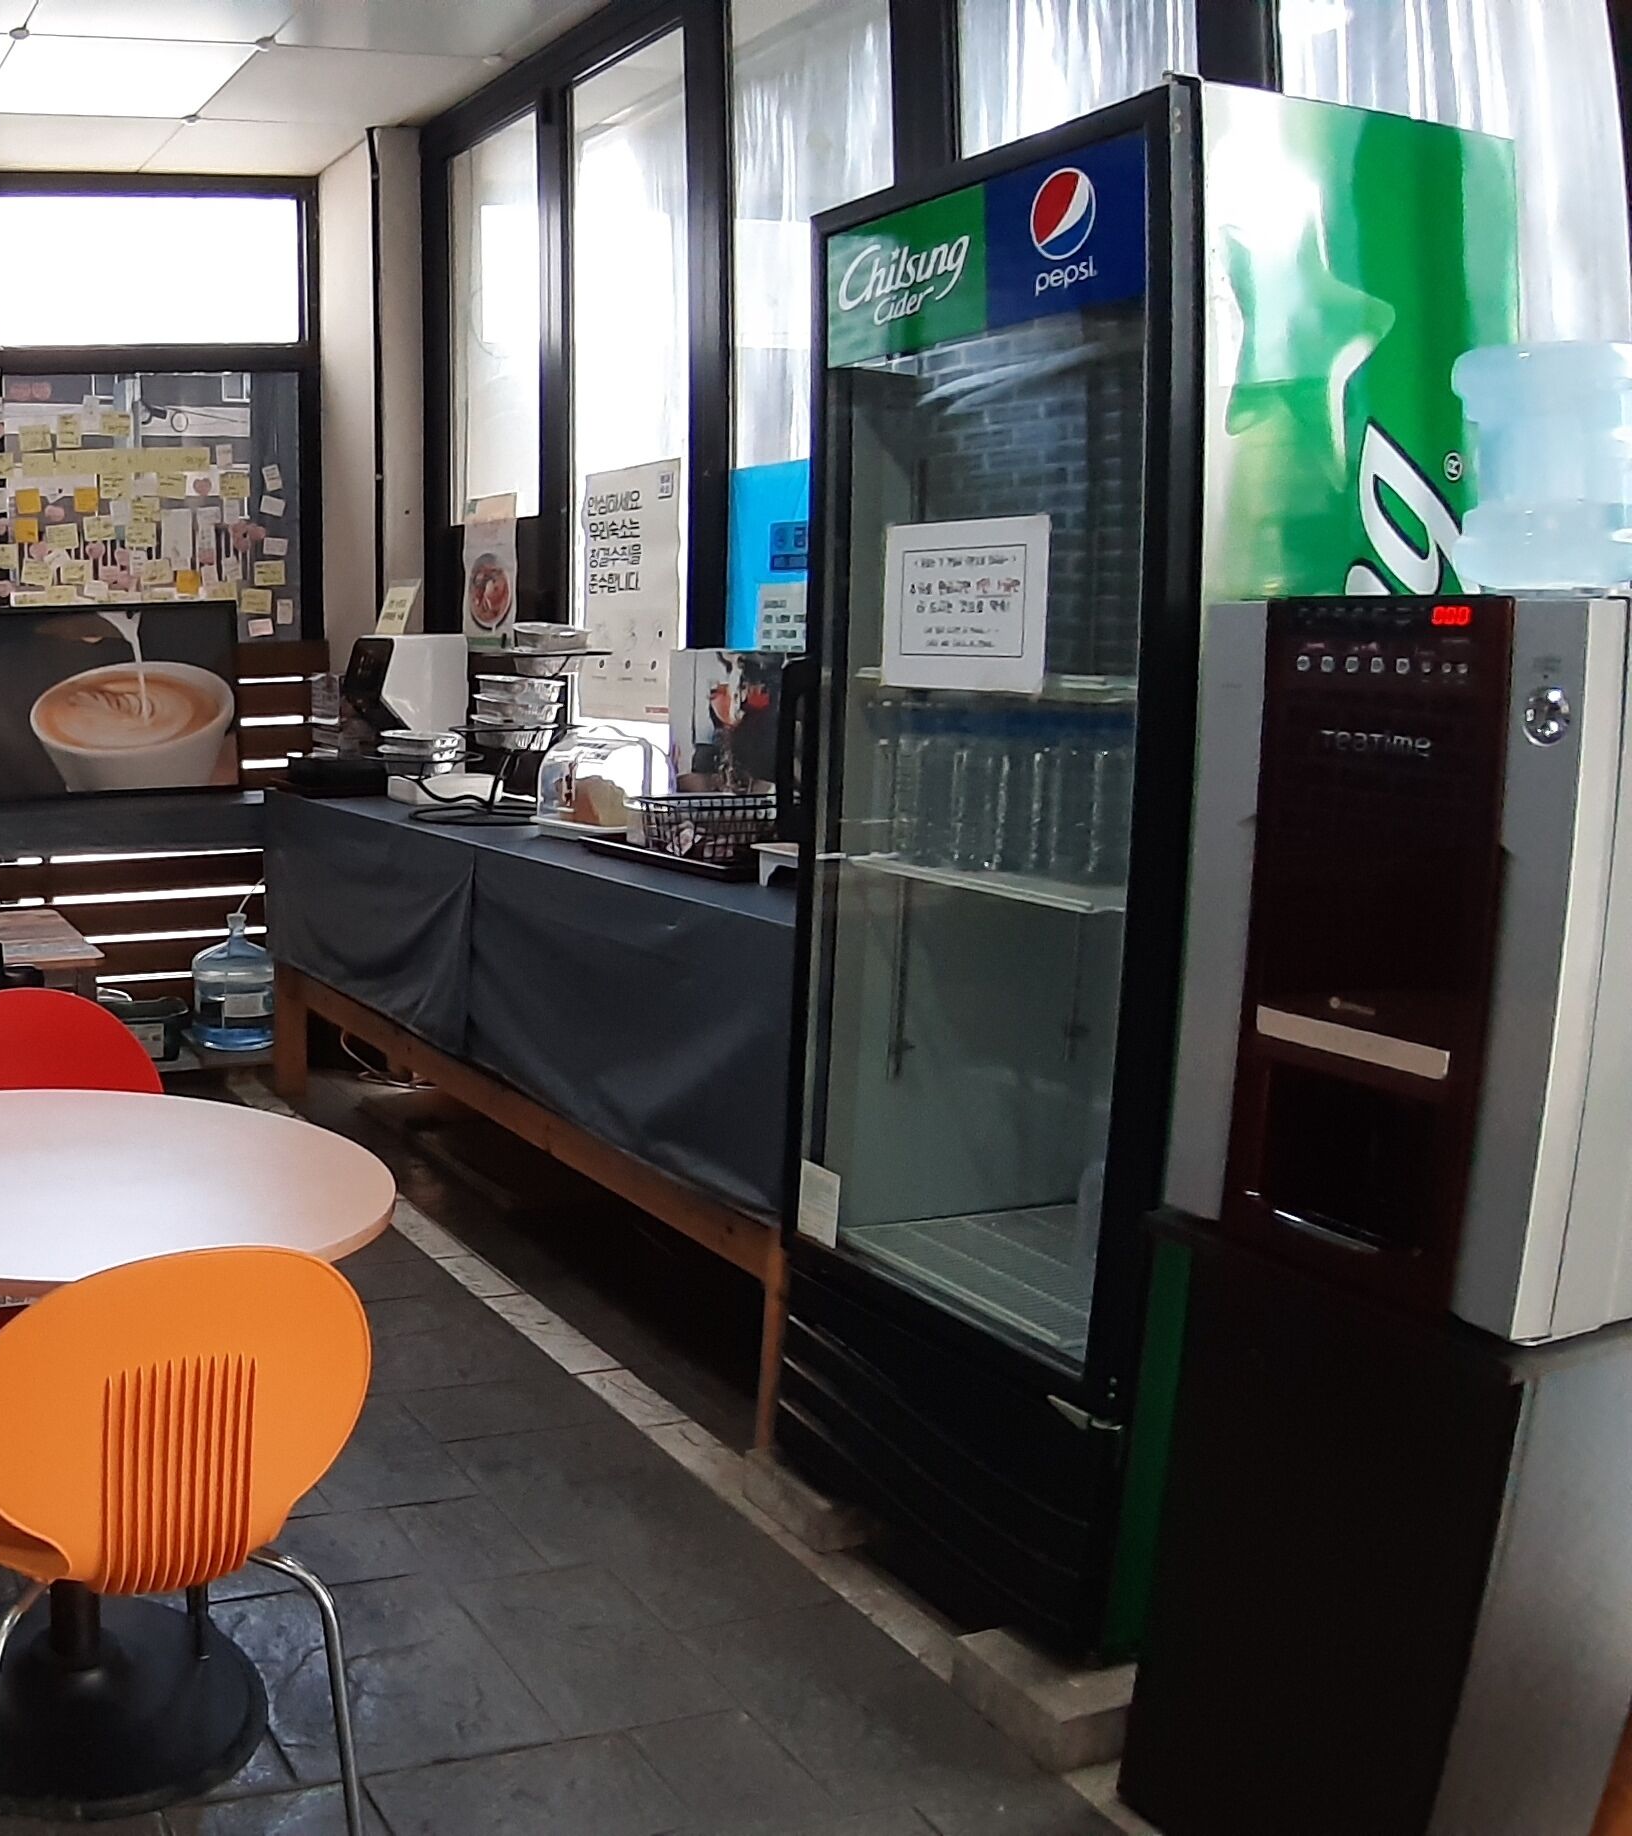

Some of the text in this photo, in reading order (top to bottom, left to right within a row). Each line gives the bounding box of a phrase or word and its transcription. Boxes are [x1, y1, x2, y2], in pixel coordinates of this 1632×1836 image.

[839, 235, 970, 311] Chilsung
[1034, 255, 1094, 297] pepsi
[873, 286, 935, 326] Cider
